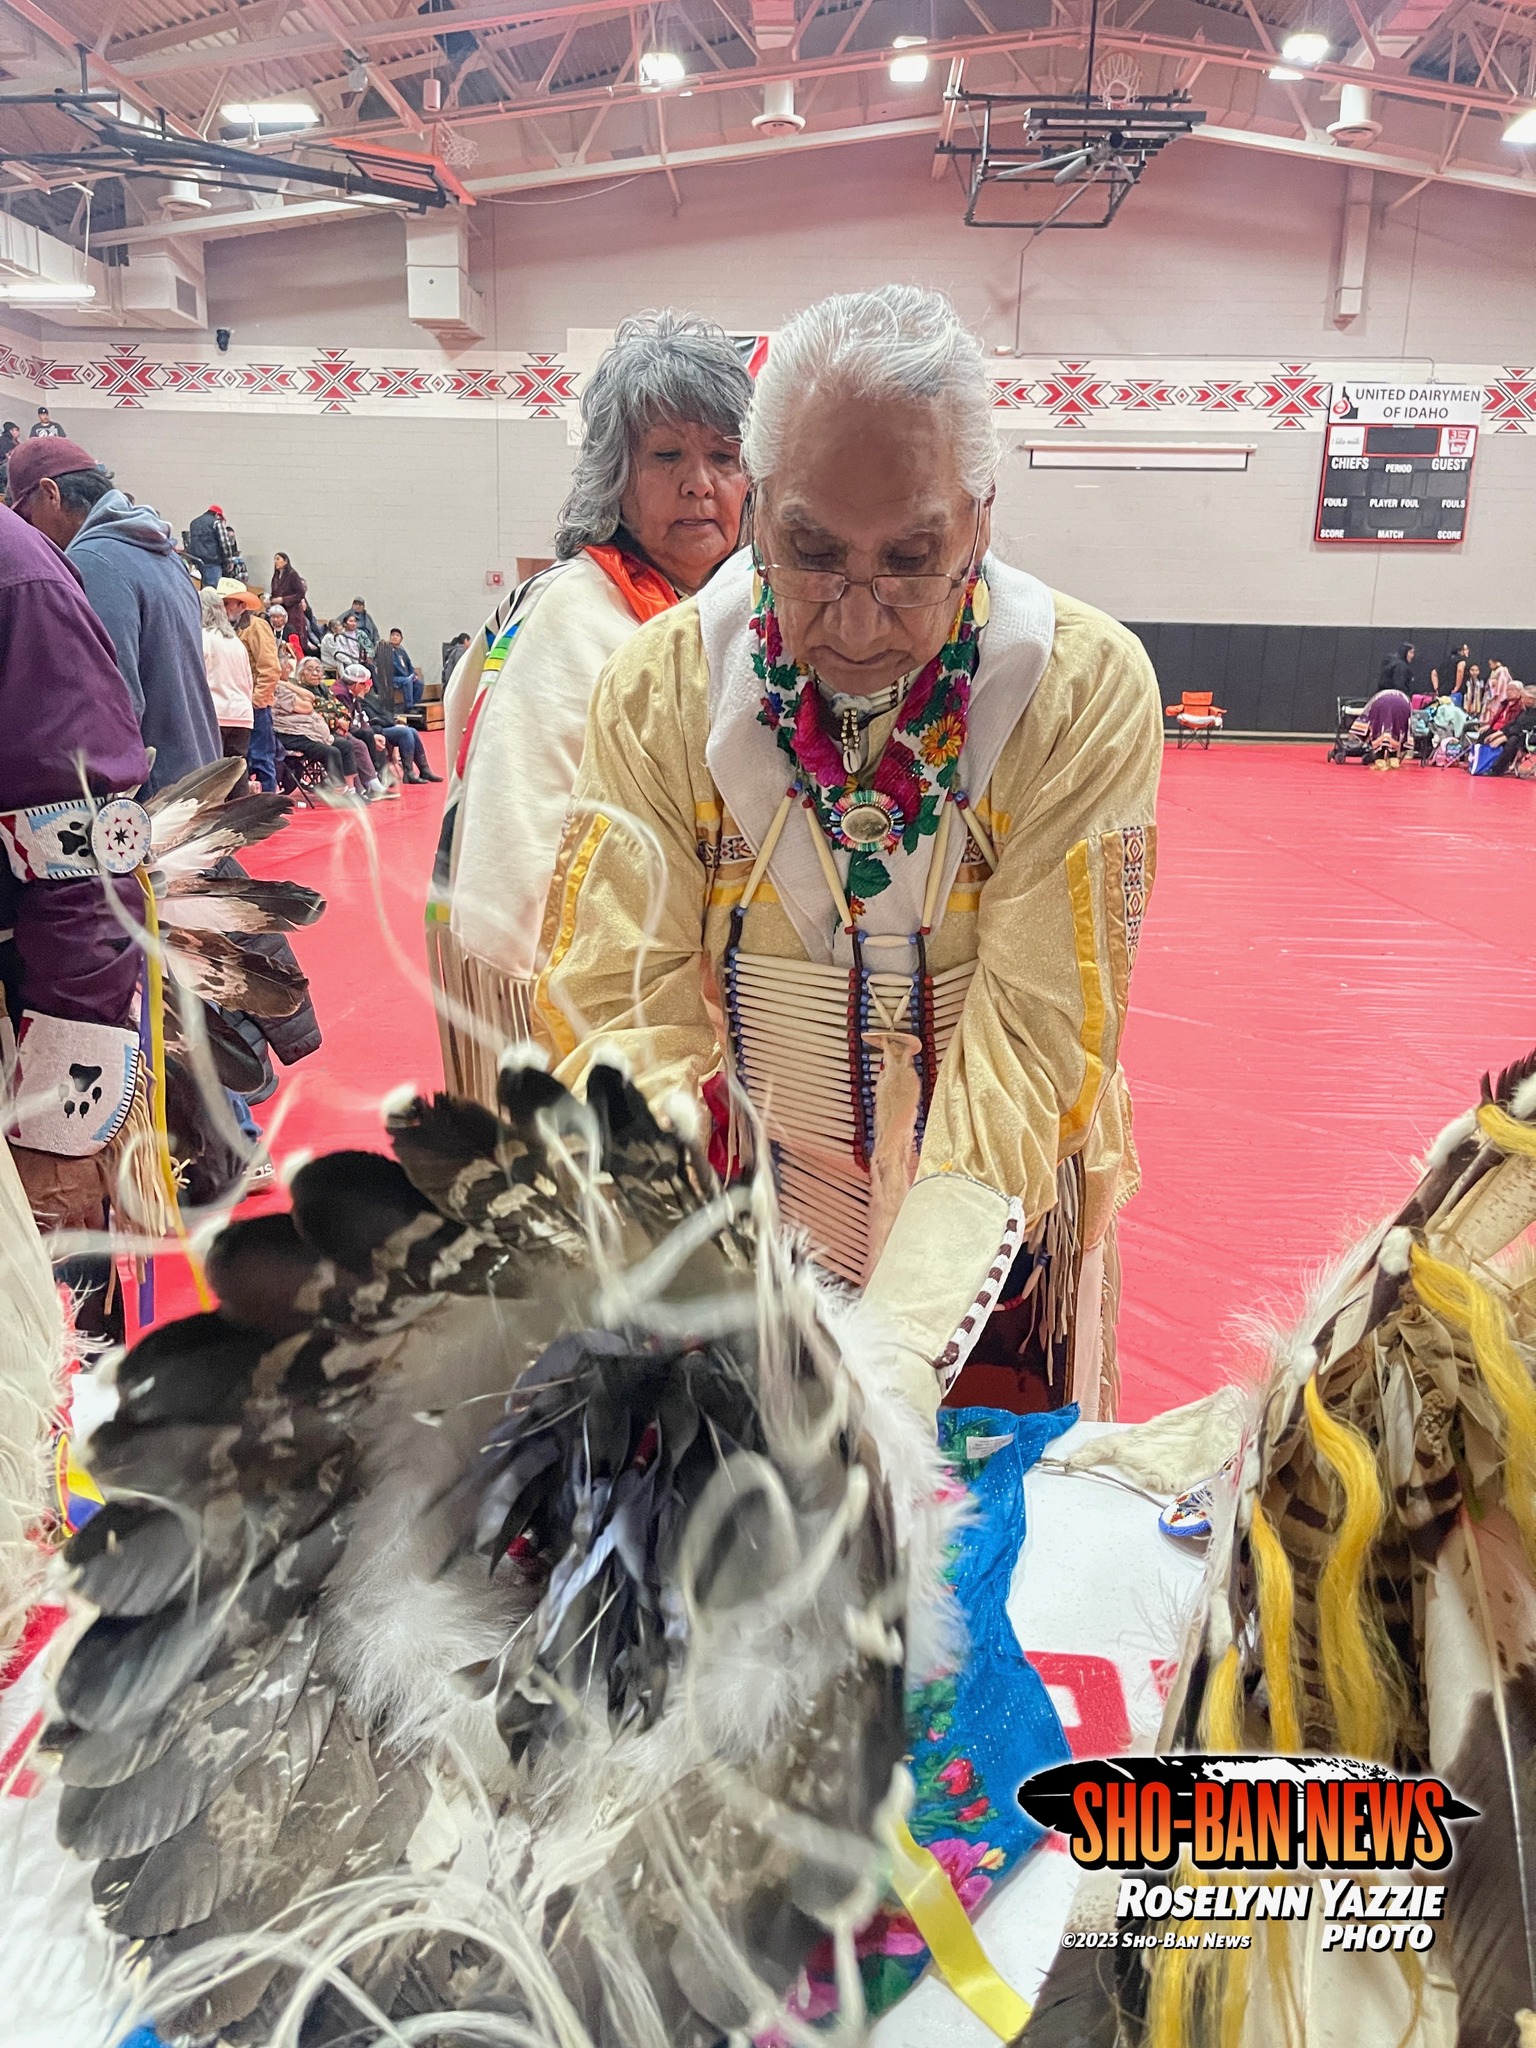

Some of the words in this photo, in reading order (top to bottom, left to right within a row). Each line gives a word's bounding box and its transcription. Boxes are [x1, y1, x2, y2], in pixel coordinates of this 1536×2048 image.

[1355, 388, 1406, 401] UNITED
[1409, 389, 1481, 402] DAIRYMEN
[1383, 406, 1401, 418] OF
[1404, 407, 1449, 419] IDAHO
[1331, 457, 1369, 470] CHIEFS
[1385, 463, 1413, 473] PERIOD
[1431, 458, 1468, 471] GUEST
[1323, 497, 1348, 507] FOULS
[1369, 498, 1398, 508] PLAYER
[1400, 498, 1419, 508] FOUL
[1441, 499, 1466, 509] FOULS
[1320, 528, 1344, 538] SCORE
[1377, 529, 1404, 539] MATCH
[1437, 530, 1461, 540] SCORE
